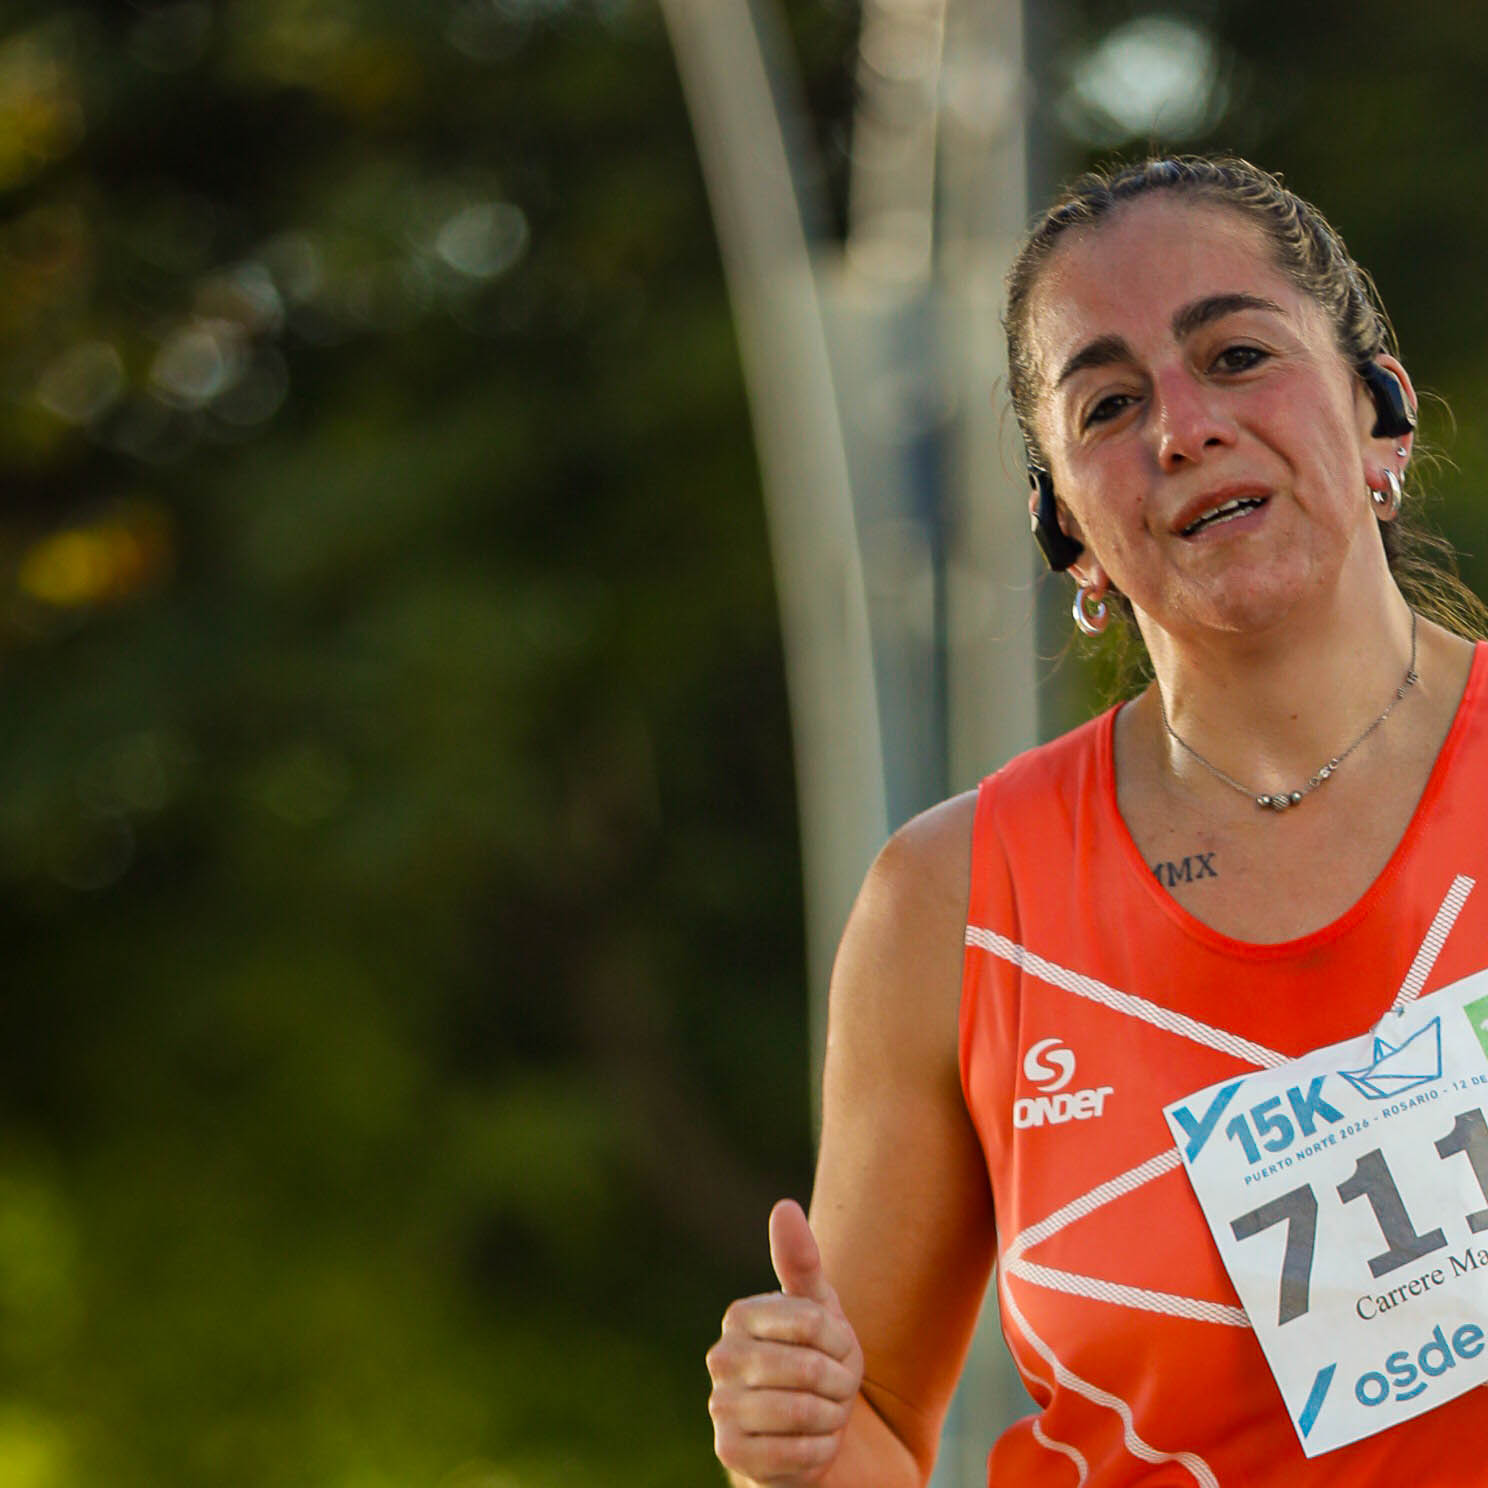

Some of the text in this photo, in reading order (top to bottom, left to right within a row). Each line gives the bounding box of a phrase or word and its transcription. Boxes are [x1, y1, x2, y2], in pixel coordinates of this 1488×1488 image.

[1225, 1074, 1345, 1165] 15K
[1244, 1156, 1294, 1185] PUERTO
[1296, 1132, 1337, 1159] NORTE
[1340, 1118, 1370, 1141] 2026
[1382, 1089, 1439, 1118] ROSARIO
[1452, 1080, 1468, 1092] 12
[1471, 1073, 1488, 1085] DE
[1355, 1266, 1446, 1321] Carrere
[1354, 1323, 1486, 1407] osde
